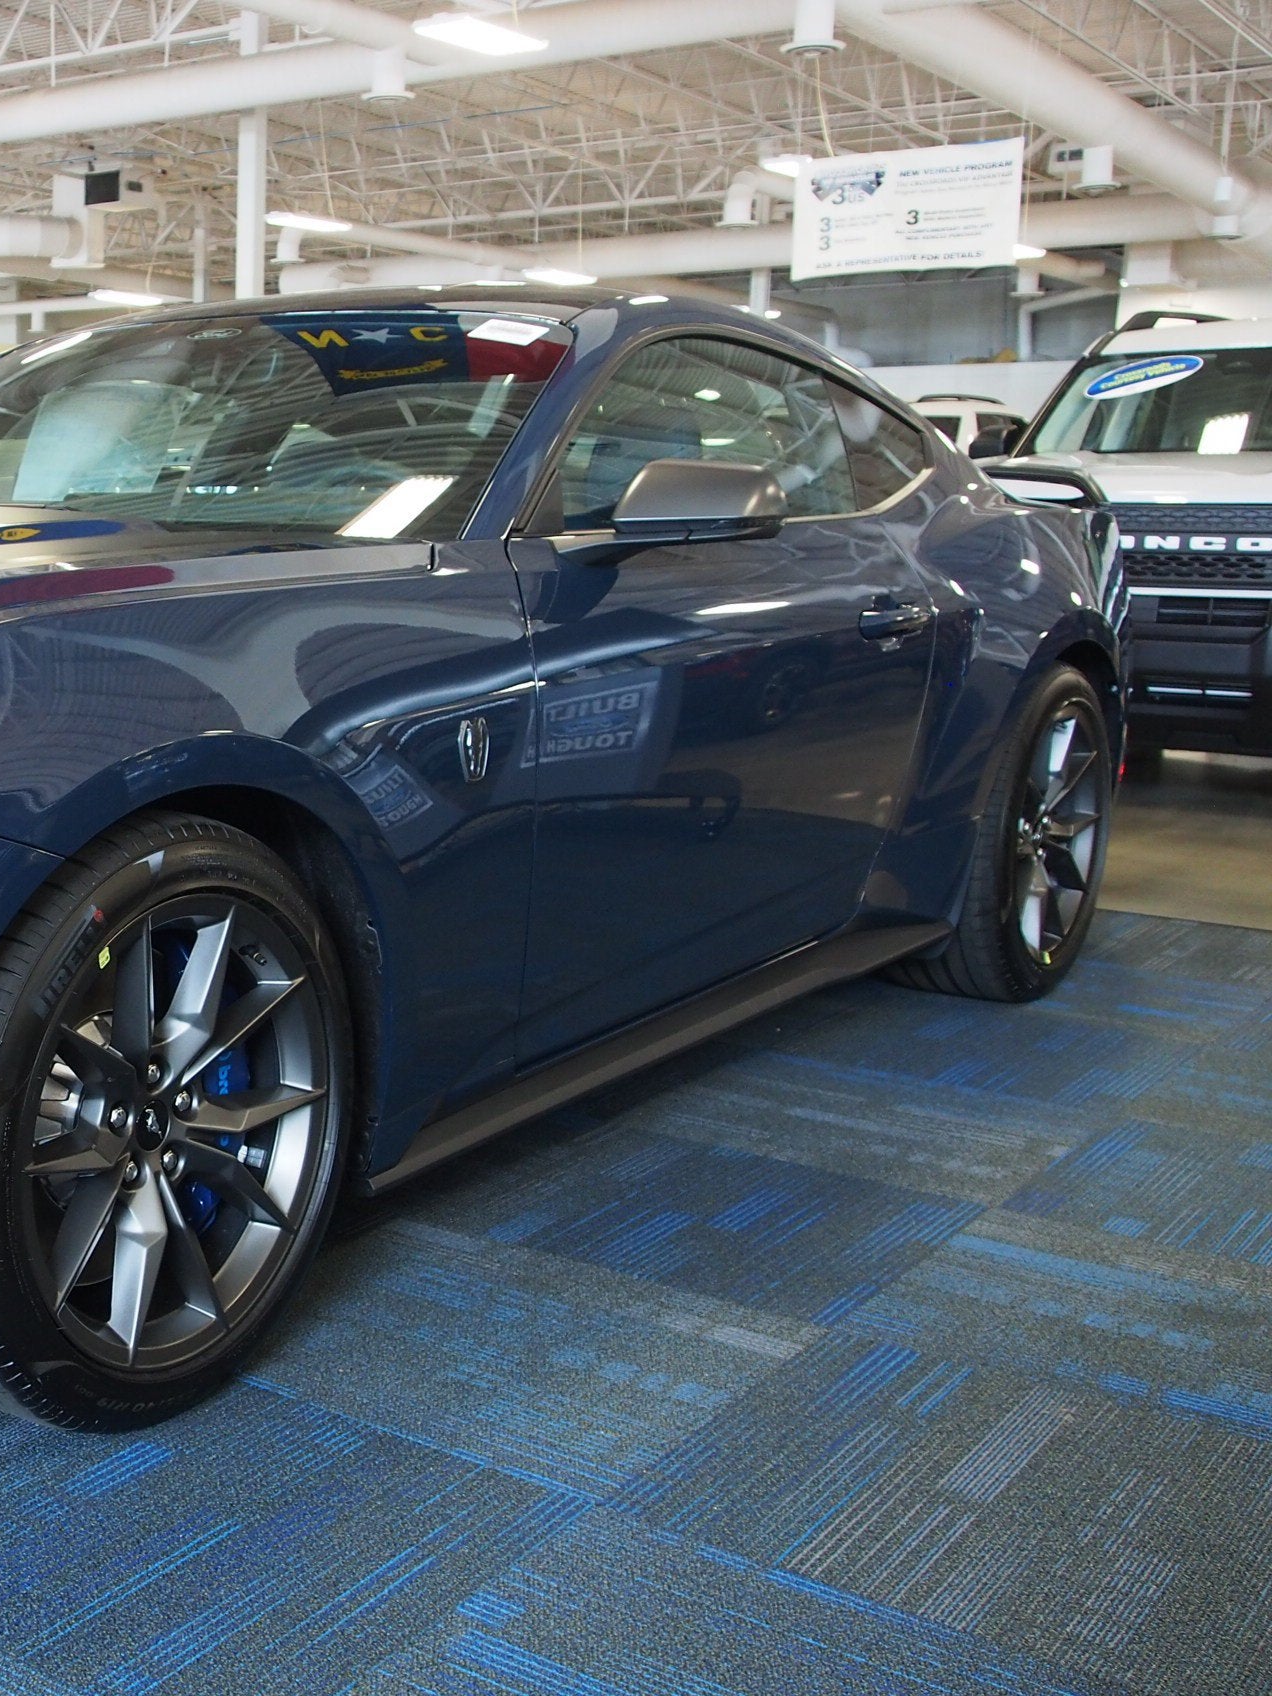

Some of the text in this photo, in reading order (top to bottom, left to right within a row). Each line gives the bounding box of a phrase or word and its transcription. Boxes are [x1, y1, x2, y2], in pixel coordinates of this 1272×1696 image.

[899, 160, 1013, 177] NEW VEHICLE PROGRAM
[820, 217, 831, 233] 3
[905, 209, 920, 226] 3
[819, 236, 831, 251] 3
